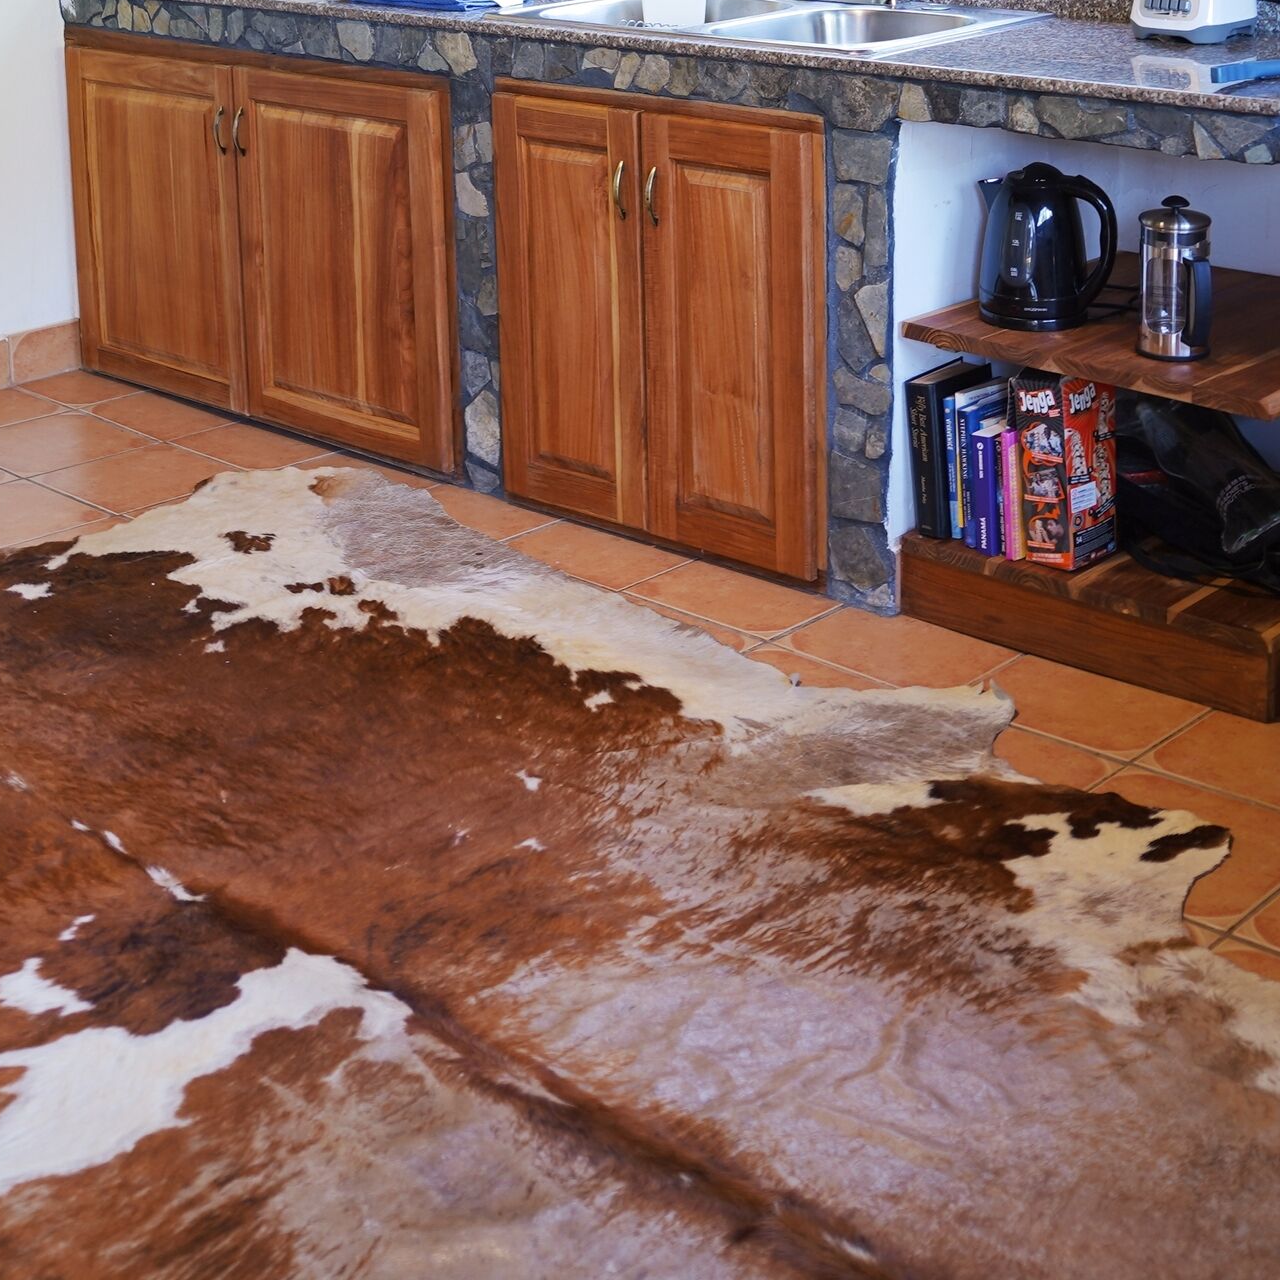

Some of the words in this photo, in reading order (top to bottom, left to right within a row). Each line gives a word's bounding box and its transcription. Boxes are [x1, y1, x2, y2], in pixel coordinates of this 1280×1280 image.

[1019, 390, 1055, 414] Jenga
[1068, 382, 1097, 414] Jenga
[960, 449, 968, 479] HAWKING
